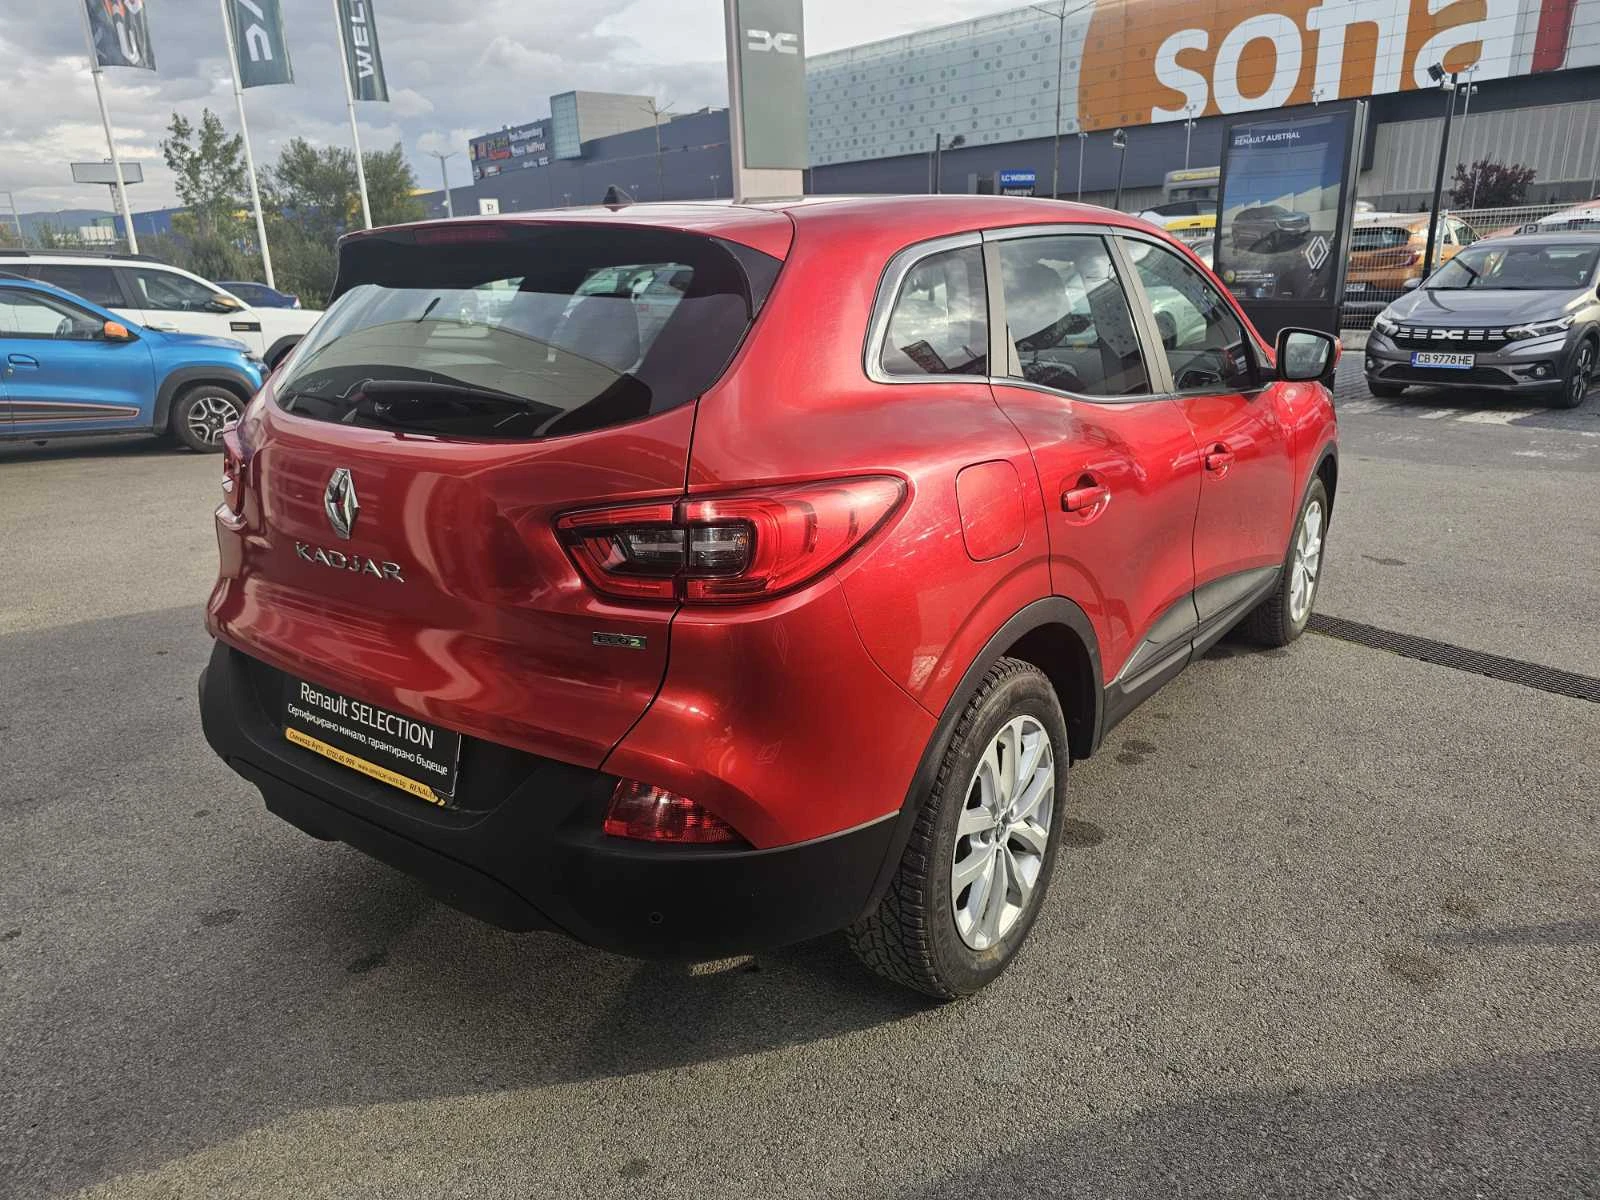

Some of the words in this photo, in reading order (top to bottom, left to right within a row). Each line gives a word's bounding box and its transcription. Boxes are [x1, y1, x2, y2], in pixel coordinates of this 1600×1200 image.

[350, 0, 375, 79] WEL
[1151, 0, 1513, 124] sofia
[1234, 135, 1265, 146] RENAULT
[1265, 131, 1301, 142] AUSTRAL
[1417, 354, 1431, 364] CB
[1432, 354, 1457, 364] 9778
[1458, 355, 1472, 365] HE
[295, 541, 404, 583] KADJAR
[287, 703, 339, 732] Сертифицирано
[339, 725, 367, 745] минало,
[368, 737, 416, 763] гарантирано
[415, 752, 448, 776] бъдеще
[300, 681, 349, 718] Renault
[350, 701, 434, 750] SELECTION
